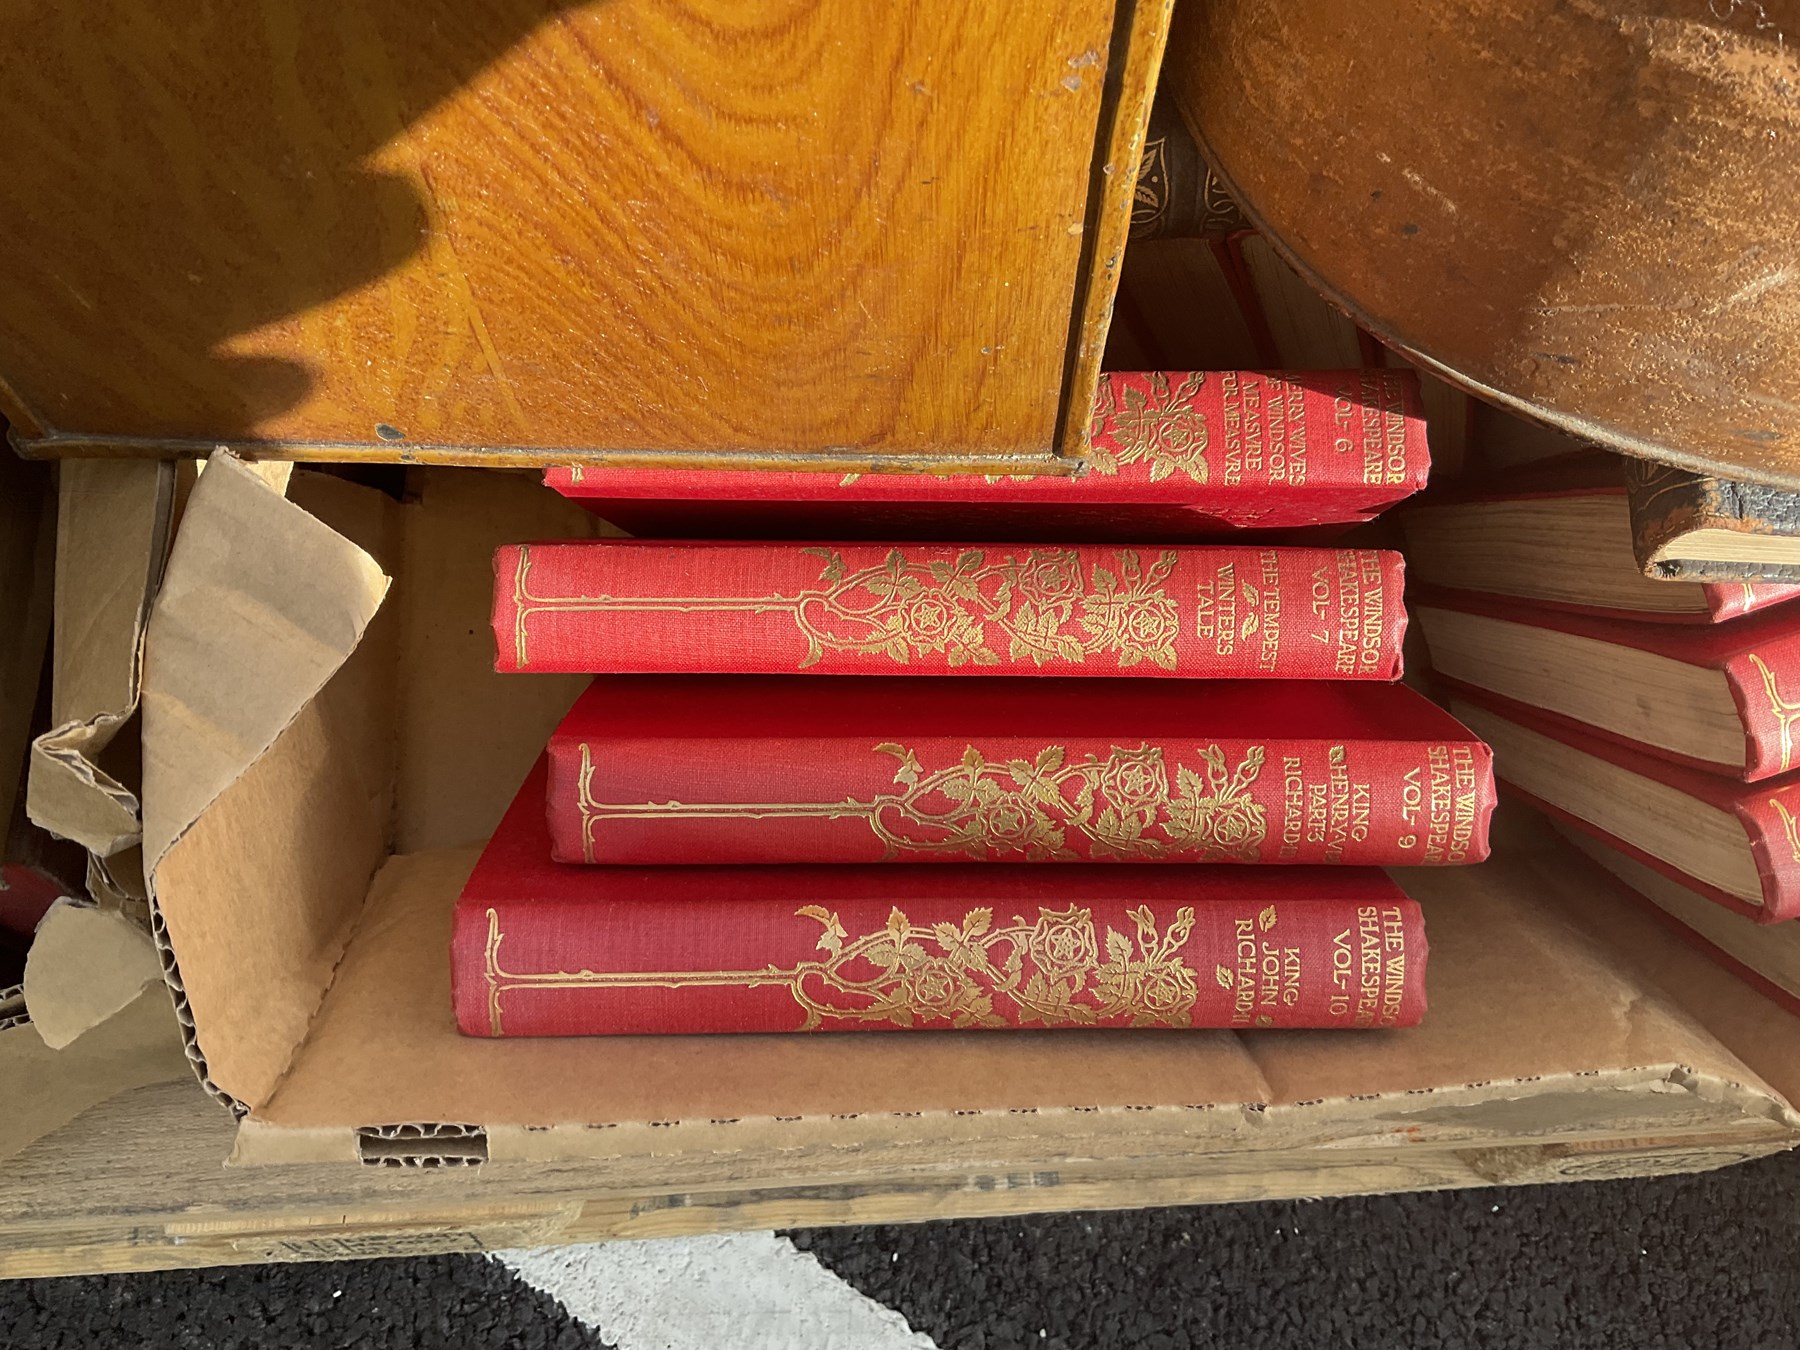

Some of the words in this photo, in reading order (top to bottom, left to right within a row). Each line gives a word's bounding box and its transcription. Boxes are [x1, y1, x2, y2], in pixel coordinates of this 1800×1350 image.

[1221, 371, 1239, 407] FOR
[1242, 381, 1262, 471] MEASVRE
[1268, 397, 1287, 485] WINDSOR
[1289, 426, 1307, 486] WIVES
[1335, 438, 1354, 453] 6
[1385, 400, 1406, 485] WINDSOR
[1260, 550, 1279, 585] THE
[1359, 551, 1383, 585] THE
[1197, 580, 1215, 639] TALE
[1216, 562, 1236, 656] WINTER'S
[1259, 587, 1280, 673] TEMPEST
[1311, 630, 1330, 644] 7
[1335, 549, 1360, 674] SHAKESPEARE
[1357, 586, 1383, 674] WINDSOR
[1453, 746, 1475, 789] THE
[1351, 783, 1370, 842] KING
[1423, 745, 1450, 864] SHAKESPEAR
[1447, 789, 1476, 864] WINDSO
[1398, 834, 1417, 849] 9
[1382, 906, 1404, 952] THE
[1261, 941, 1279, 1006] JOHN
[1283, 947, 1300, 1007] KING
[1379, 952, 1405, 1025] WINDSO
[1329, 993, 1350, 1015] 10
